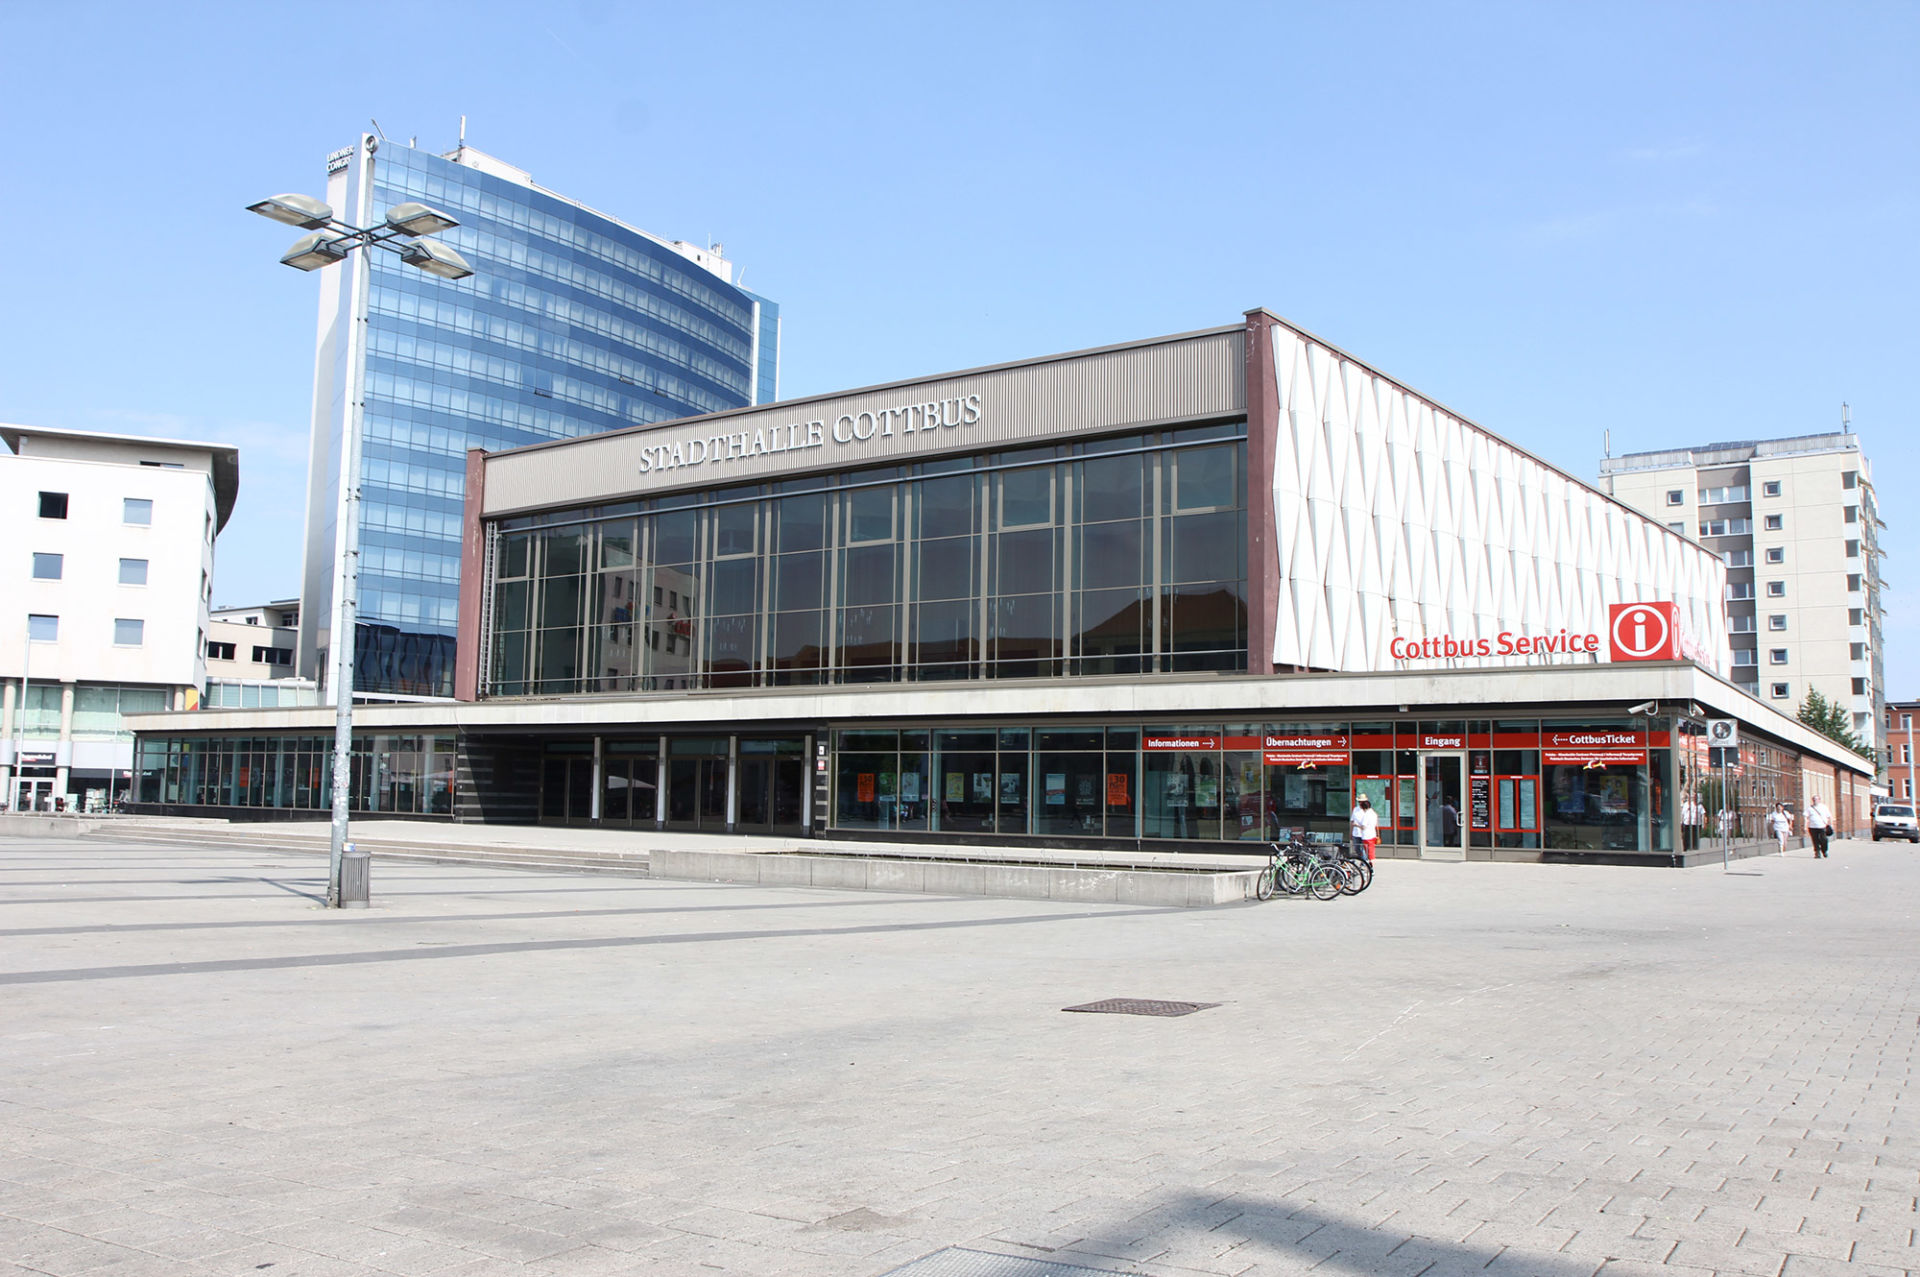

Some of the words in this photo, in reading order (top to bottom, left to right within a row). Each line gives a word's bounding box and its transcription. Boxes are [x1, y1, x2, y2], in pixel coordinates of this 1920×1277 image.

[639, 419, 824, 473] STADTHALLE
[833, 393, 981, 443] COTTBUS
[1148, 739, 1199, 748] Informationen
[1266, 736, 1332, 748] Übernachtungen
[1425, 736, 1461, 747] Eingang
[1569, 734, 1635, 744] CottbusTicket
